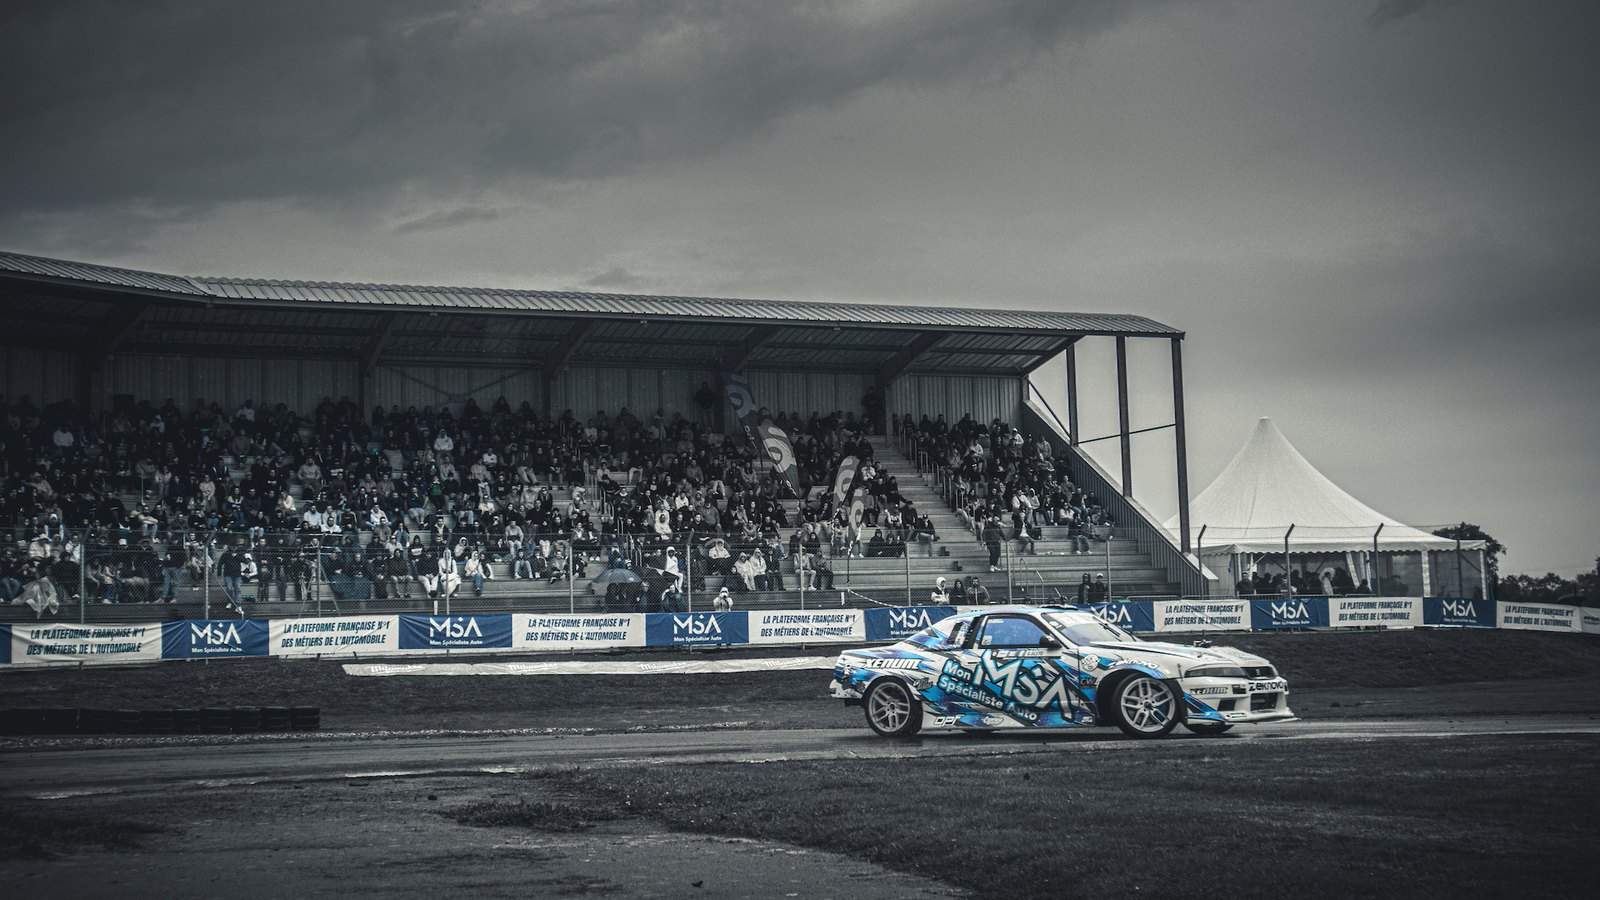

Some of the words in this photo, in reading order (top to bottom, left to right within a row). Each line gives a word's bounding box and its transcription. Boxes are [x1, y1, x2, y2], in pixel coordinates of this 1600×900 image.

[1166, 605, 1173, 613] LA
[1173, 605, 1206, 613] PLATEFORME
[1206, 605, 1233, 615] FRANÇAISE
[1271, 601, 1310, 619] MSA
[1378, 601, 1403, 611] FRANÇAISE
[1442, 599, 1477, 617] MSA
[1505, 605, 1511, 613] LA
[1512, 606, 1540, 614] PLATEFORME
[1541, 607, 1565, 618] FRANÇAISE
[763, 615, 771, 624] LA
[772, 615, 810, 624] PLATEFORME
[811, 614, 843, 626] FRANÇAISE
[844, 614, 856, 623] N°1
[889, 608, 933, 628] MSA
[1164, 617, 1174, 625] DES
[1175, 615, 1197, 625] MÉTIERS
[1197, 616, 1205, 624] DE
[1205, 616, 1241, 624] L'AUTOMOBILE
[1338, 613, 1348, 621] DES
[1348, 612, 1369, 621] MÉTIERS
[1377, 612, 1410, 620] L'AUTOMOBILE
[1504, 616, 1512, 624] DES
[1513, 615, 1533, 625] MÉTIERS
[1533, 617, 1540, 625] DE
[1540, 618, 1572, 628] L'AUTOMOBILE
[283, 624, 292, 633] LA
[293, 623, 335, 633] PLATEFORME
[336, 621, 376, 633] FRANÇAISE
[377, 620, 390, 630] N°1
[429, 617, 483, 638] MSA
[528, 619, 537, 627] LA
[538, 619, 581, 628] PLATEFORME
[582, 618, 617, 630] FRANÇAISE
[618, 618, 630, 627] N°1
[673, 614, 722, 635] MSA
[30, 629, 40, 640] LA
[42, 628, 91, 639] PLATEFORME
[92, 628, 131, 641] FRANÇAISE
[132, 627, 145, 638] N°1
[191, 622, 242, 645] MSA
[525, 632, 539, 641] DES
[540, 630, 569, 641] MÉTIERS
[570, 632, 579, 640] DE
[580, 631, 627, 640] L'AUTOMOBILE
[761, 628, 773, 637] DES
[774, 626, 800, 637] MÉTIERS
[801, 627, 809, 636] DE
[810, 626, 852, 636] L'AUTOMOBILE
[281, 638, 293, 648] DES
[294, 636, 323, 647] MÉTIERS
[324, 637, 333, 646] DE
[335, 634, 386, 646] L'AUTOMOBILE
[26, 644, 41, 655] DES
[43, 642, 77, 655] MÉTIERS
[79, 644, 88, 655] DE
[90, 642, 142, 654] L'AUTOMOBILE
[943, 660, 971, 680] Mon
[973, 649, 1073, 720] MSA
[939, 675, 1004, 709] Spécialiste
[1006, 702, 1038, 721] Auto
